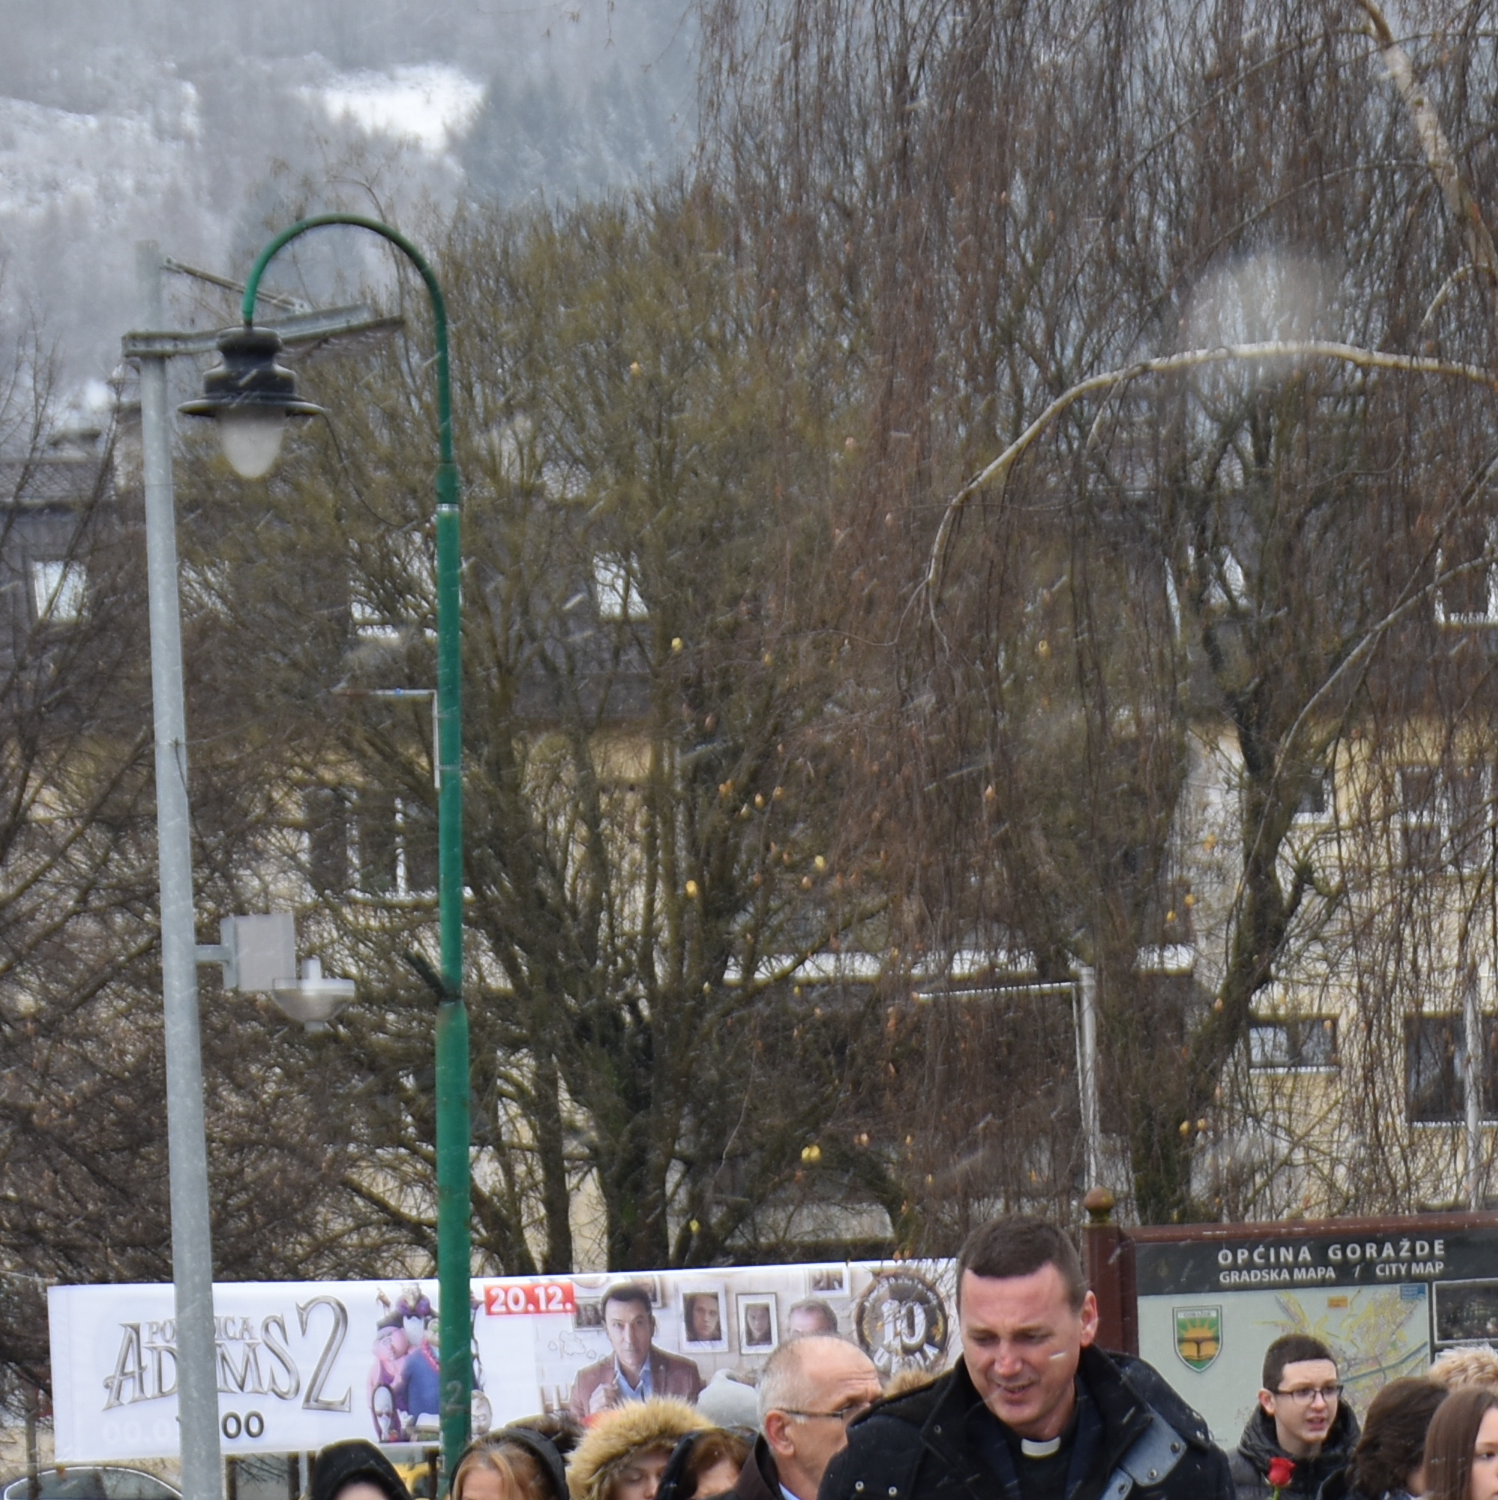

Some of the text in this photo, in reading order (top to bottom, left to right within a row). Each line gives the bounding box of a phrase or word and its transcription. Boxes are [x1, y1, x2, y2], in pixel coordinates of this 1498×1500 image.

[1218, 1238, 1445, 1264] OPĆINA GORAŽDE
[1219, 1268, 1290, 1283] GRADSKA
[1293, 1265, 1336, 1280] MAPA
[1376, 1263, 1407, 1276] CITY
[1411, 1260, 1445, 1275] MAP
[489, 1285, 573, 1312] 20.12.
[146, 1315, 256, 1343] POICA
[101, 1295, 352, 1412] ADMS 2
